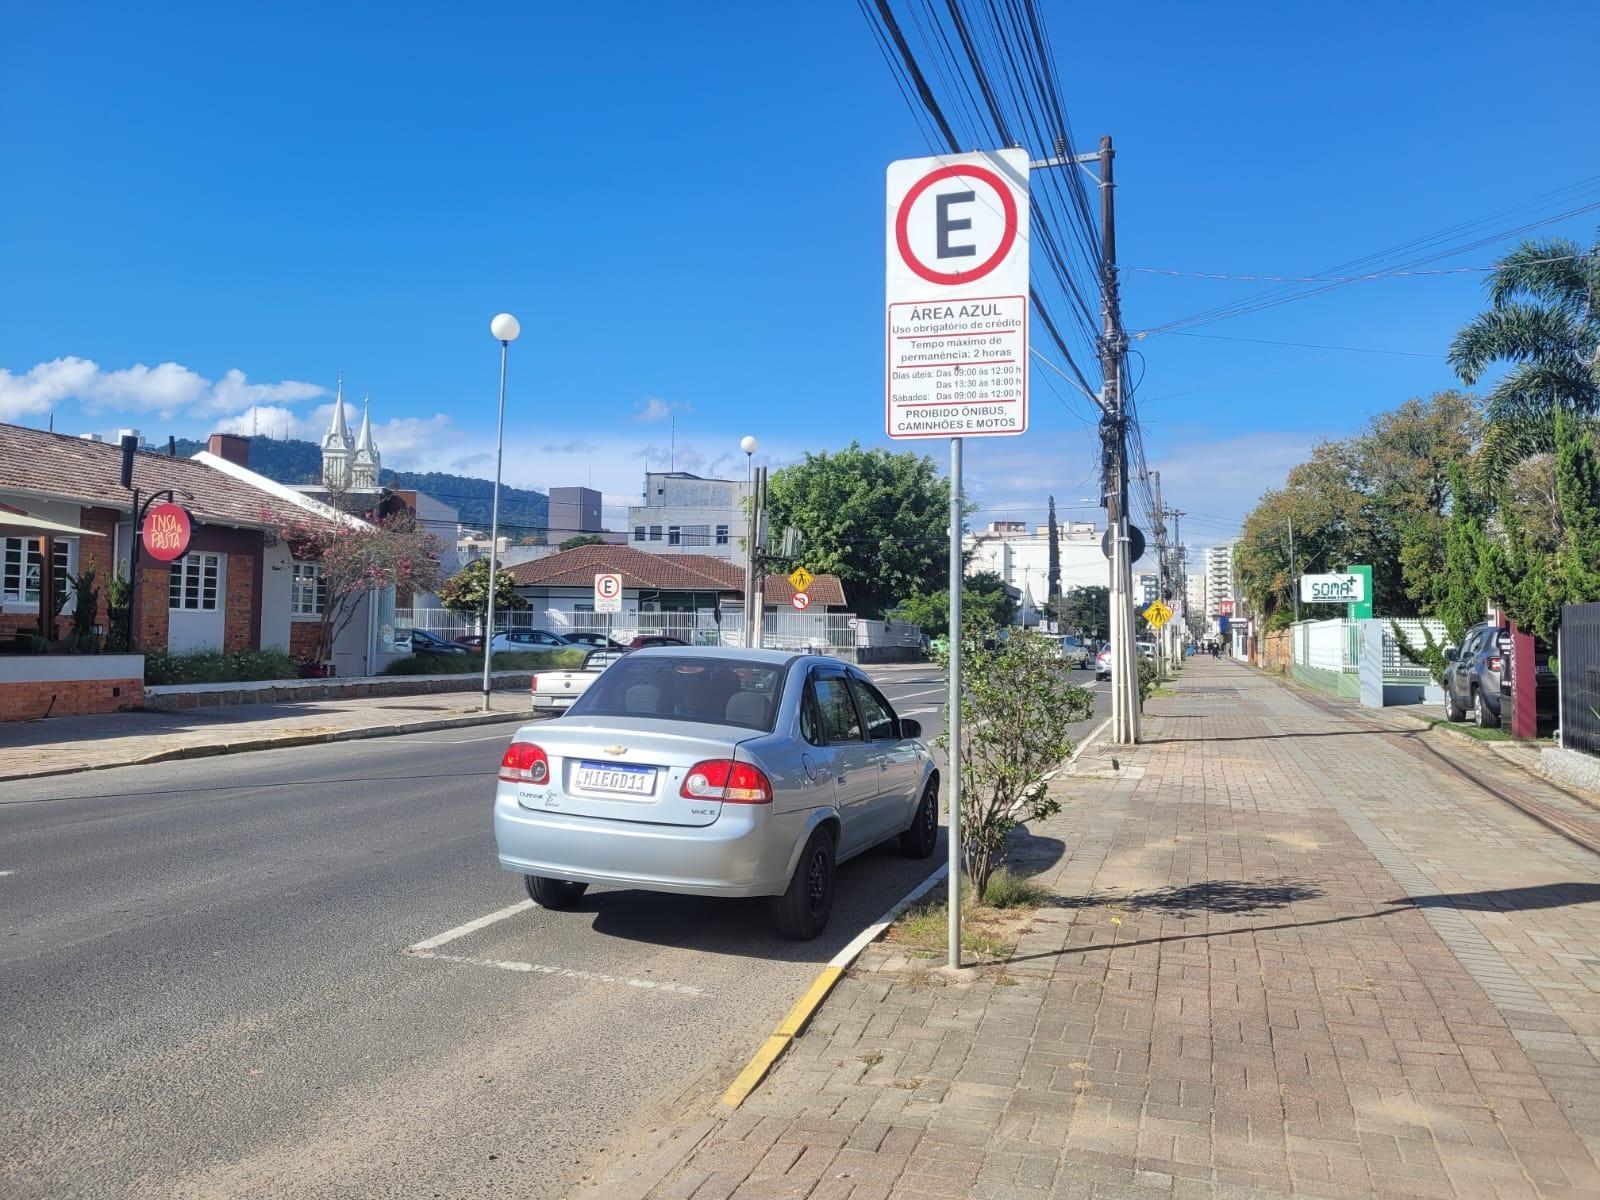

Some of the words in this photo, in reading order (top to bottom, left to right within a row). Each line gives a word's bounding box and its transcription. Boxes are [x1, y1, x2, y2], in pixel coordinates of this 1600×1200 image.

[936, 190, 976, 260] E
[910, 305, 954, 321] ÁREA
[959, 303, 1002, 317] AZUL
[892, 325, 911, 334] Uso
[913, 321, 968, 333] obrigatório
[970, 320, 983, 329] de
[985, 318, 1021, 328] crédito
[911, 340, 944, 350] Tempo
[946, 337, 986, 347] máximo
[989, 336, 1002, 345] de
[901, 350, 971, 364] permanência:
[974, 349, 980, 358] 2
[982, 348, 1012, 357] horas
[892, 371, 910, 380] Dias
[936, 369, 952, 378] Das
[954, 367, 977, 377] 09:00
[991, 366, 1014, 375] 12:00
[1016, 365, 1021, 374] h
[936, 381, 952, 389] Das
[954, 379, 977, 388] 13:30
[991, 378, 1014, 386] 18:00
[1016, 377, 1021, 385] h
[892, 393, 930, 402] Sábados:
[936, 392, 952, 400] Das
[954, 390, 977, 400] 09:00
[991, 389, 1014, 398] 12:00
[1016, 388, 1021, 397] h
[906, 408, 959, 419] PROIBIDO
[961, 405, 1007, 417] ÔNIBUS,
[898, 420, 964, 431] CAMINHÕES
[966, 420, 973, 429] E
[976, 418, 1016, 428] MOTOS
[151, 514, 177, 532] INSA
[151, 531, 181, 549] PASTA
[604, 580, 612, 593] E
